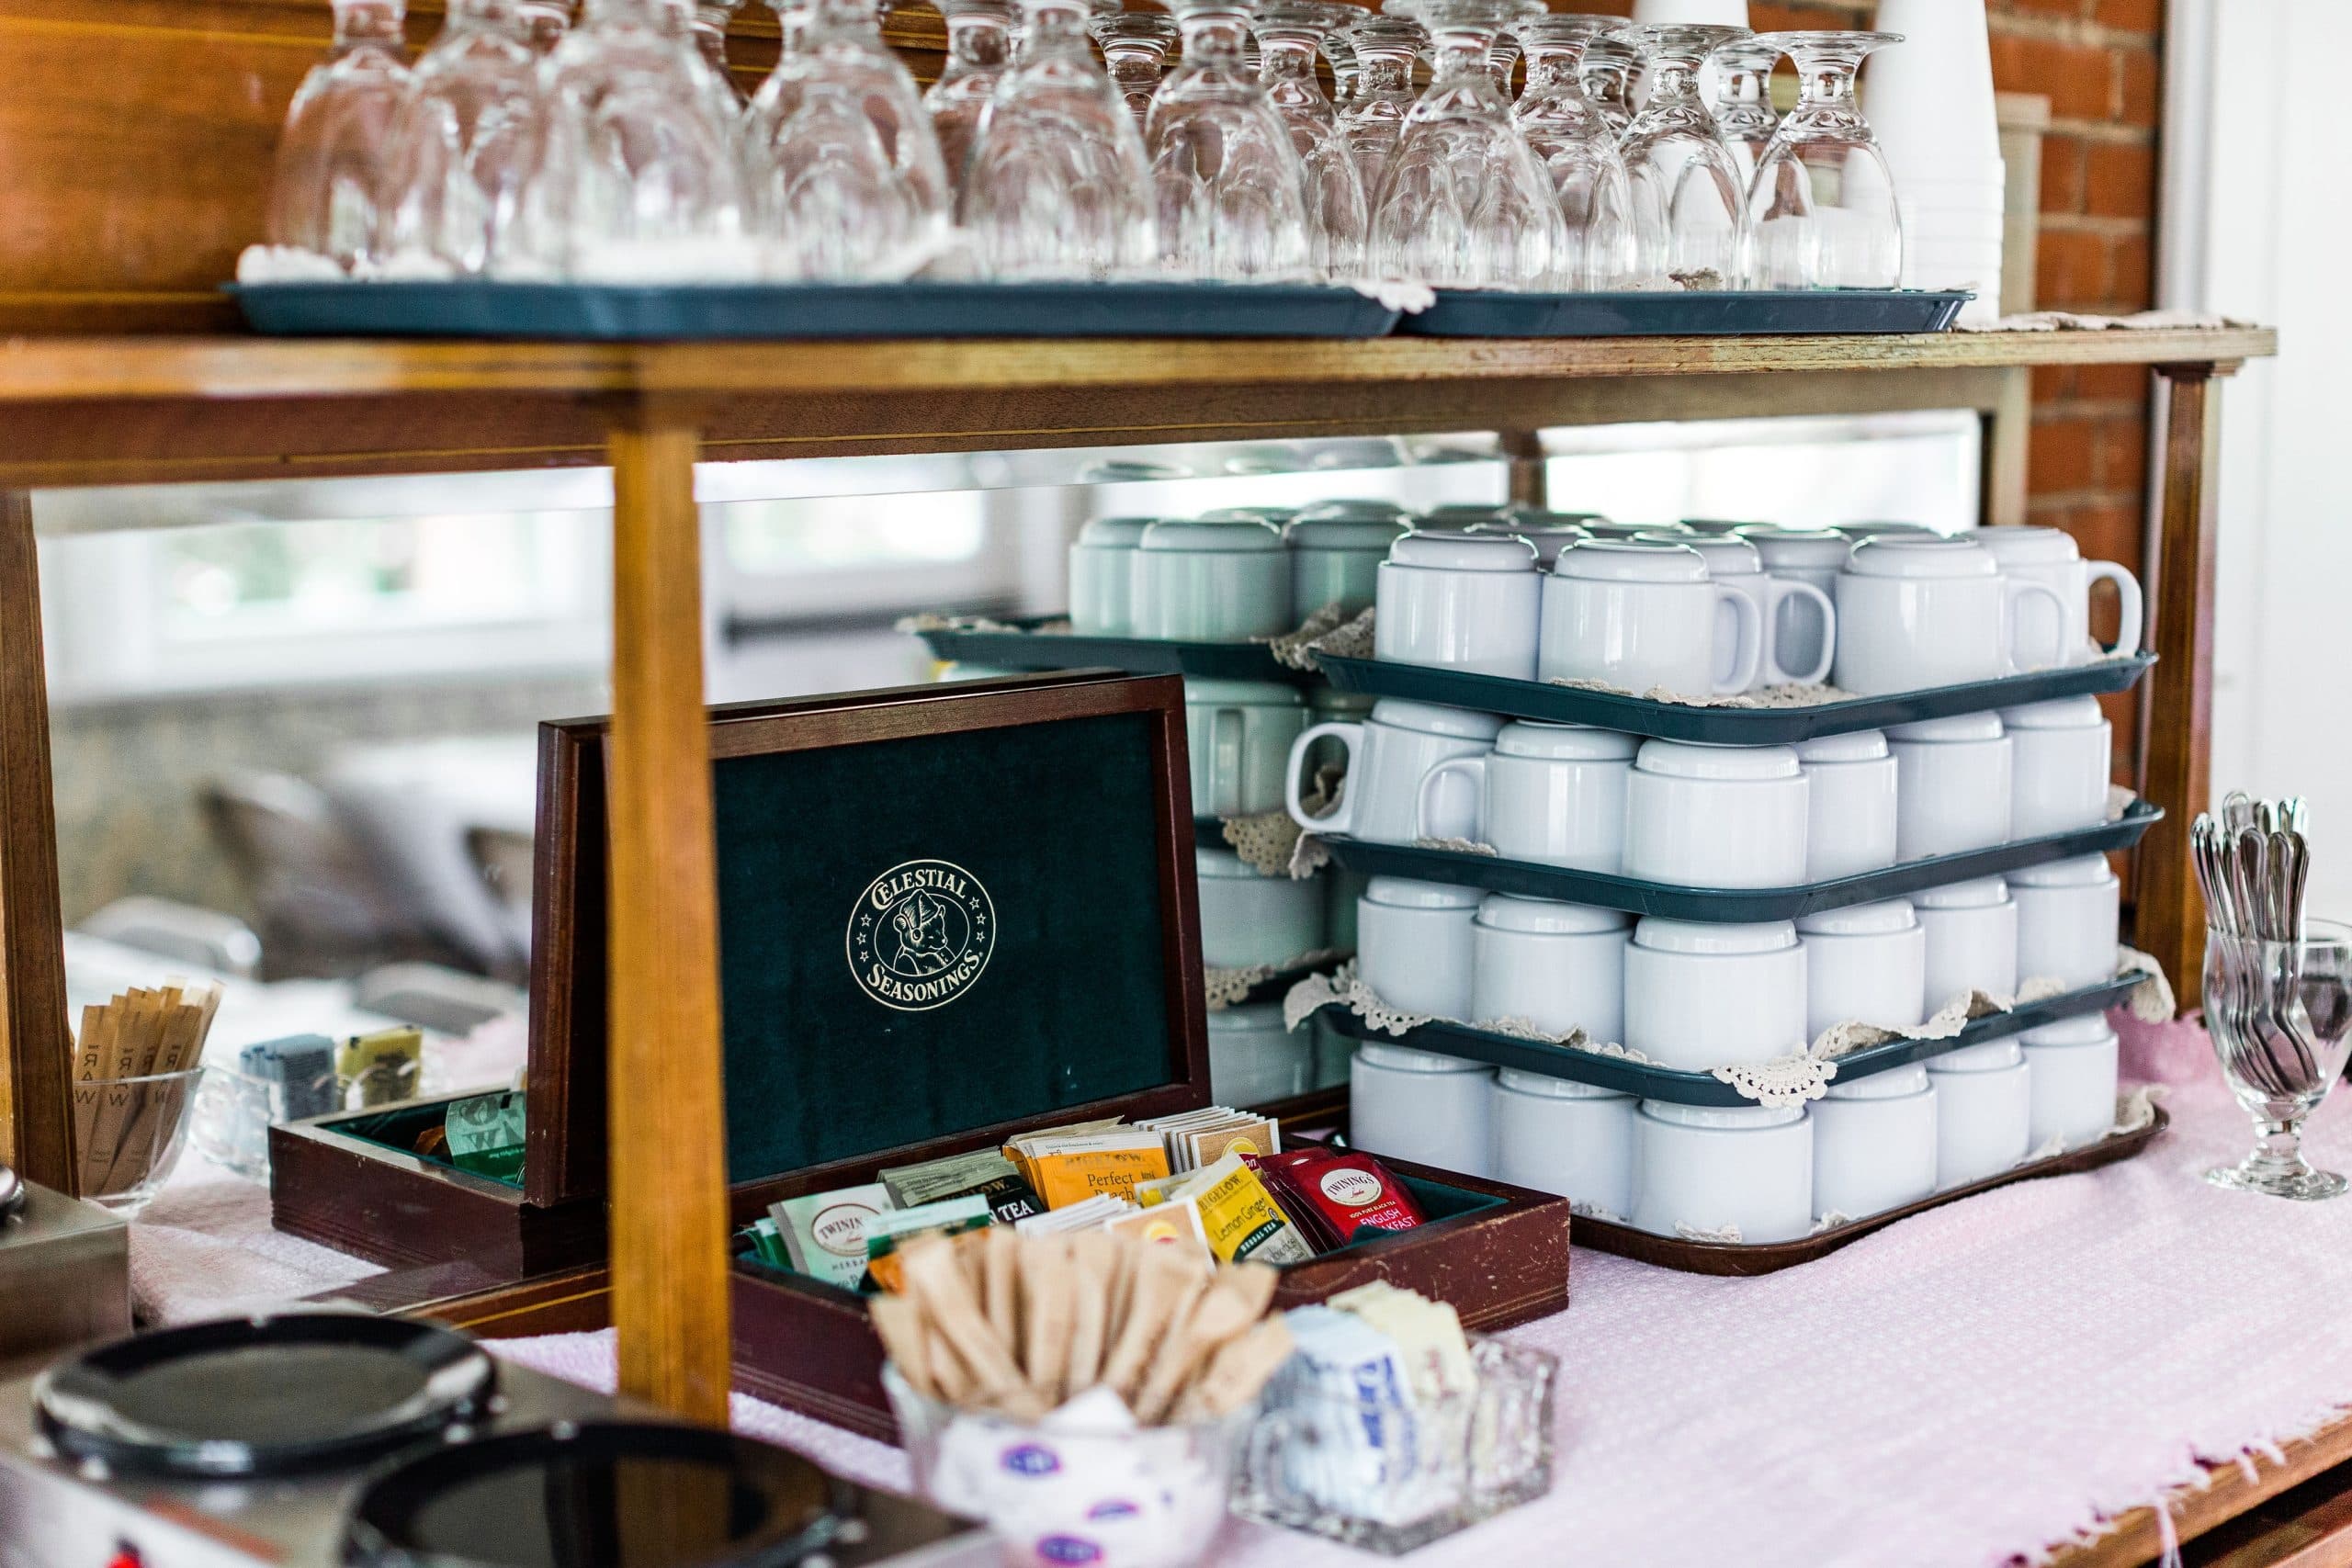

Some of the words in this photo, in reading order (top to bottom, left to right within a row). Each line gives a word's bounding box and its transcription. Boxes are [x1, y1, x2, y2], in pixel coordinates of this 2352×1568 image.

[871, 869, 967, 910] CELESTIAL
[866, 949, 980, 1001] SEASONINGS
[1087, 1171, 1135, 1186] Perfect
[1327, 1176, 1374, 1196] TWININGS
[1197, 1174, 1240, 1211] BIGELOW
[997, 1200, 1035, 1222] TEA
[1214, 1214, 1245, 1242] Lemon
[1240, 1197, 1268, 1220] Ginger
[1360, 1208, 1402, 1225] ENGLISH
[1374, 1202, 1388, 1212] BLACK
[1240, 1229, 1264, 1252] HERBAL
[1264, 1222, 1277, 1233] TEA
